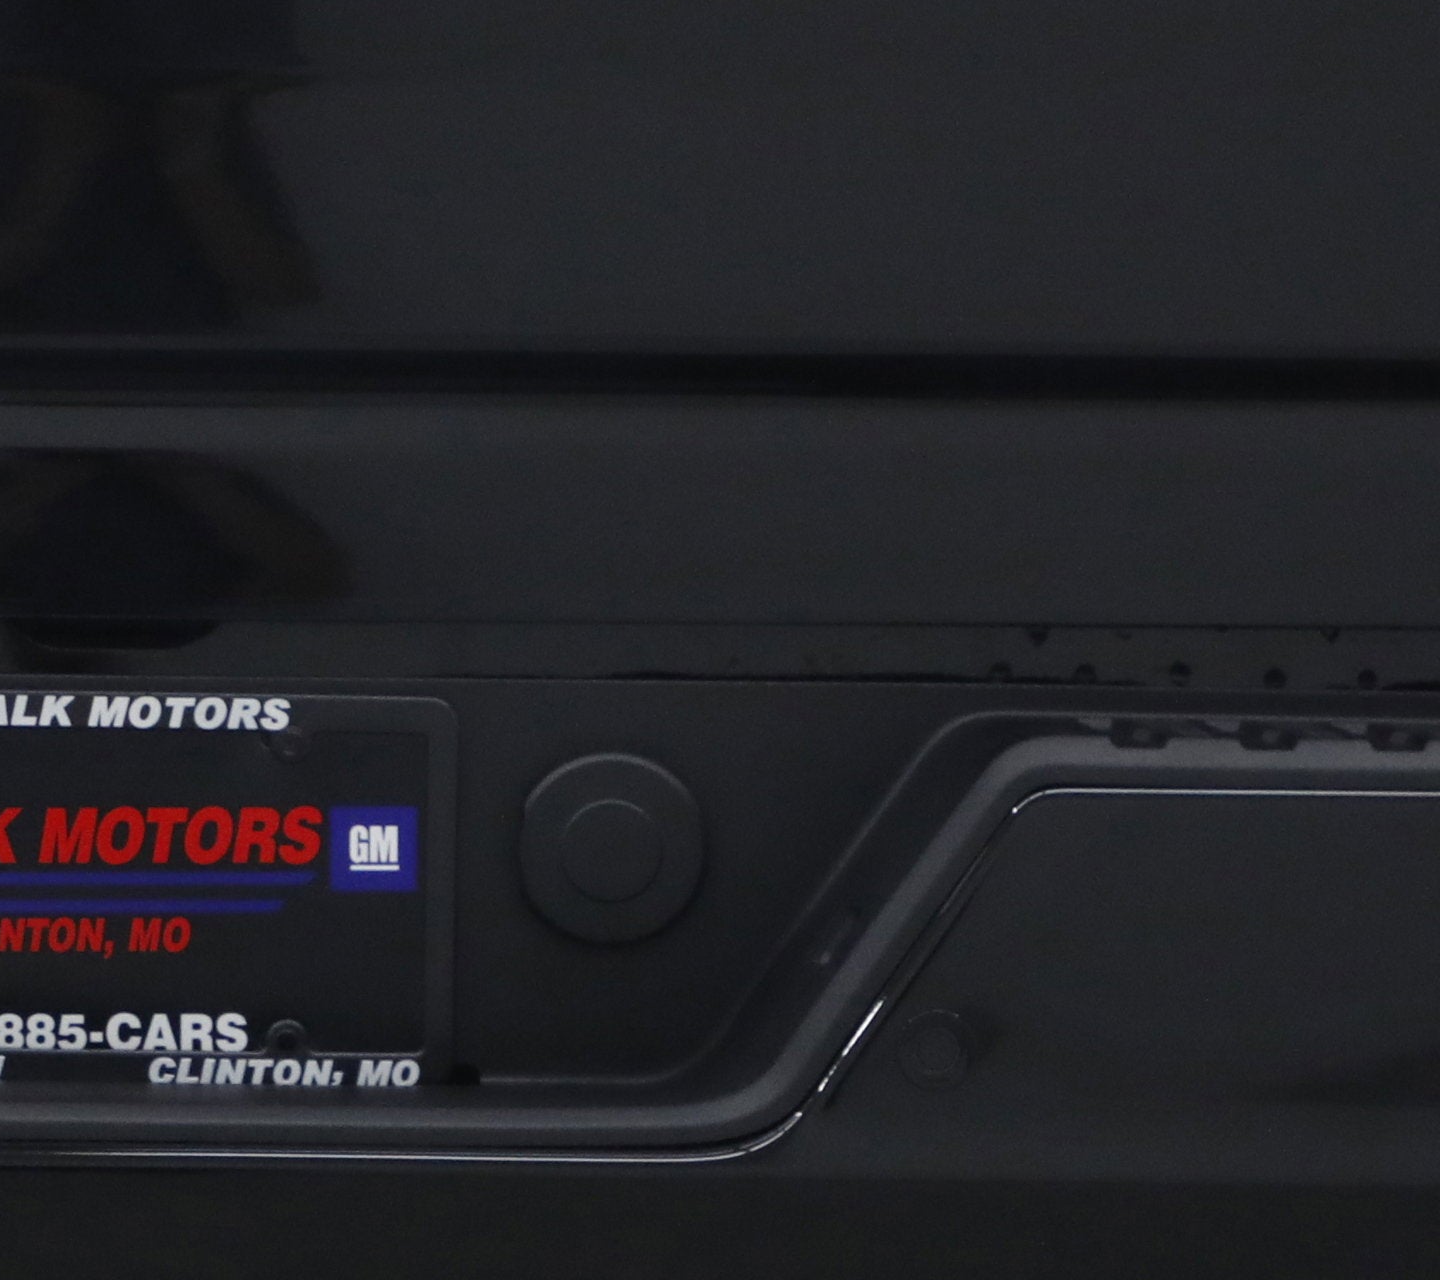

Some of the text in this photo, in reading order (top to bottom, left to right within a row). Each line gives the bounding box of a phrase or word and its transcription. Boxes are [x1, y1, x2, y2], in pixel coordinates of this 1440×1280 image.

[87, 696, 292, 731] MOTORS
[37, 805, 323, 866] MOTORS
[348, 824, 401, 866] GM
[127, 917, 191, 954] MO
[147, 1055, 421, 1087] CLINTON, MO
